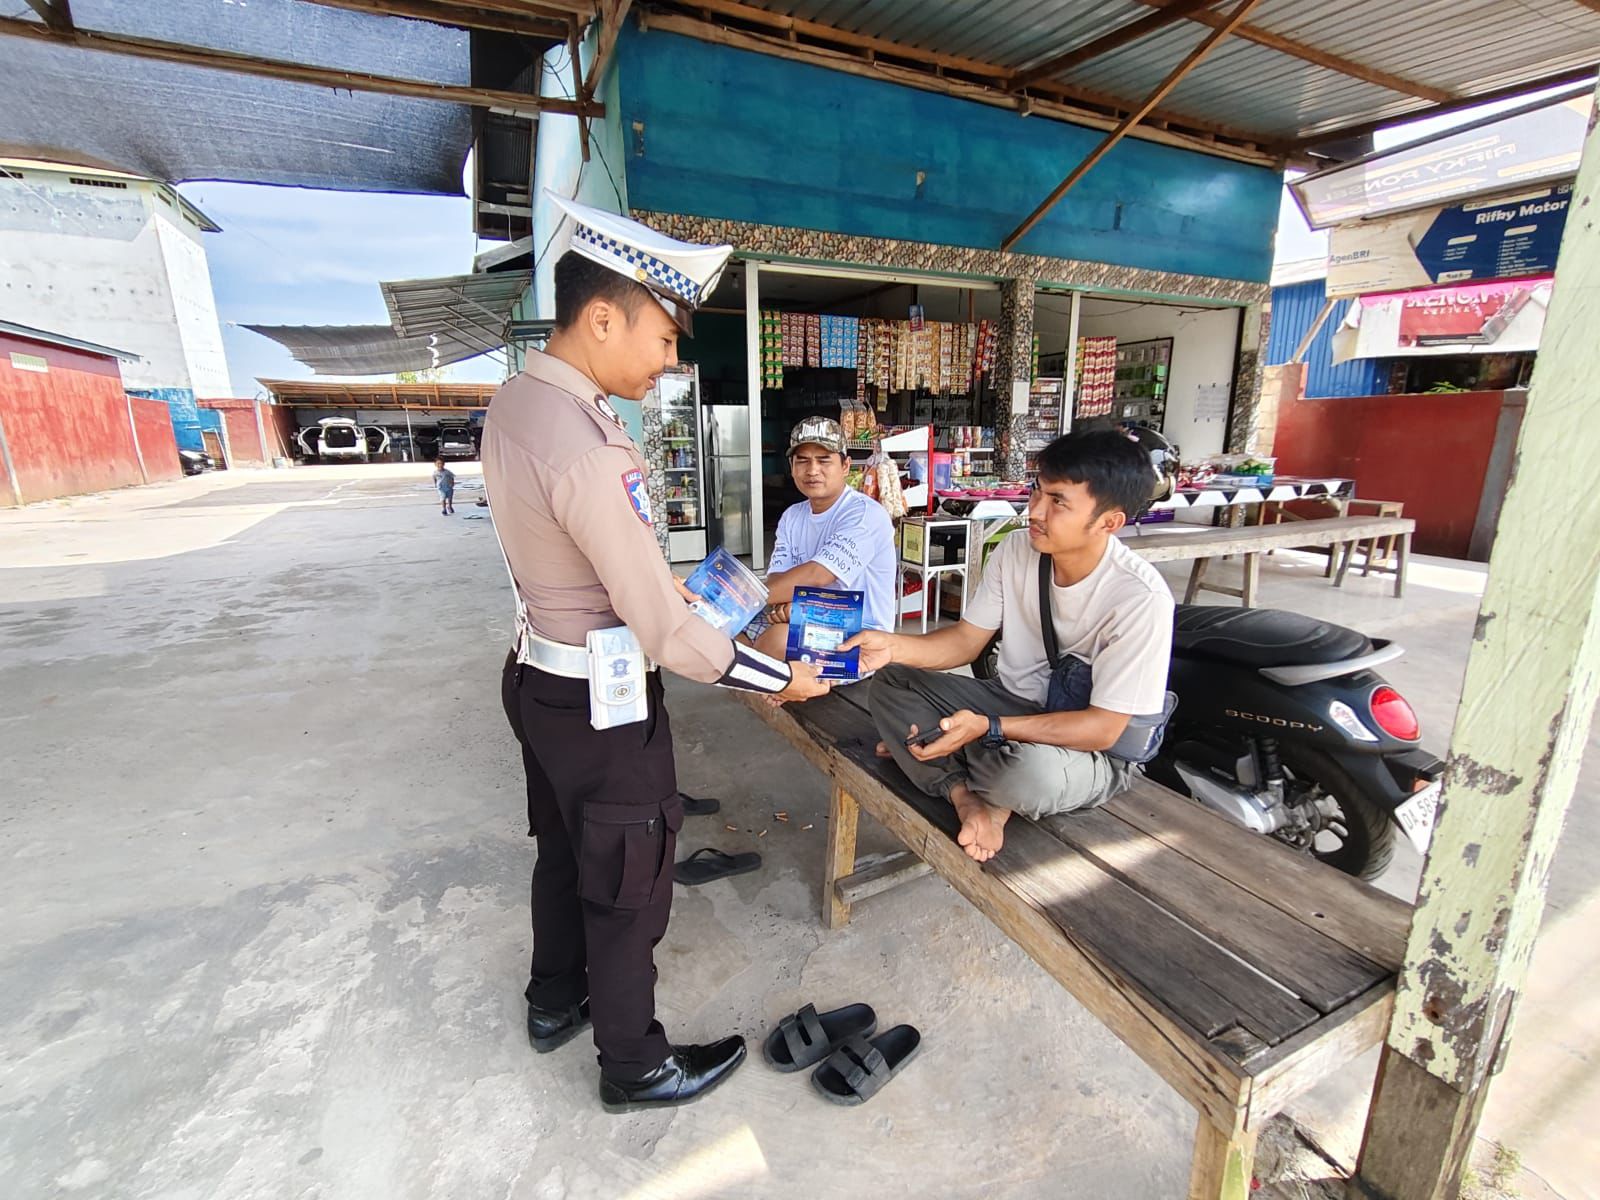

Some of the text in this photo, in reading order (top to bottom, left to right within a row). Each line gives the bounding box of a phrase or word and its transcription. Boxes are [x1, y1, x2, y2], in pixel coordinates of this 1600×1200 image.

[1519, 200, 1568, 217] Motor
[1329, 249, 1370, 264] AgenBRI
[1225, 709, 1324, 732] SCOOPY
[1401, 809, 1420, 830] DA
